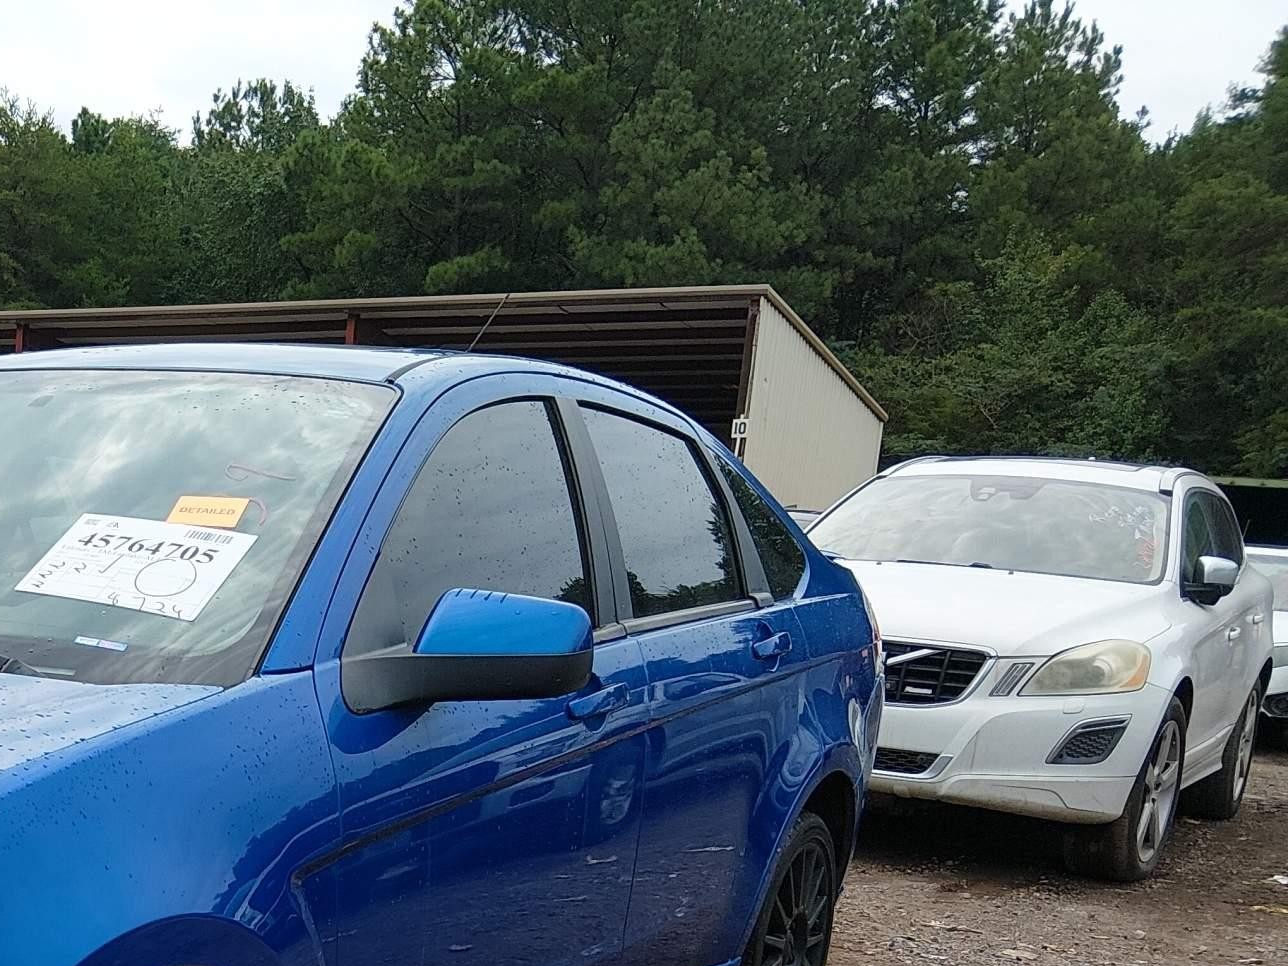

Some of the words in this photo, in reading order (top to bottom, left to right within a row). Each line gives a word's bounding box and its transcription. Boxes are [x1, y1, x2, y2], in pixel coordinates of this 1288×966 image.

[734, 422, 747, 435] 10
[178, 506, 237, 516] DETAILED
[78, 532, 220, 564] 45764705
